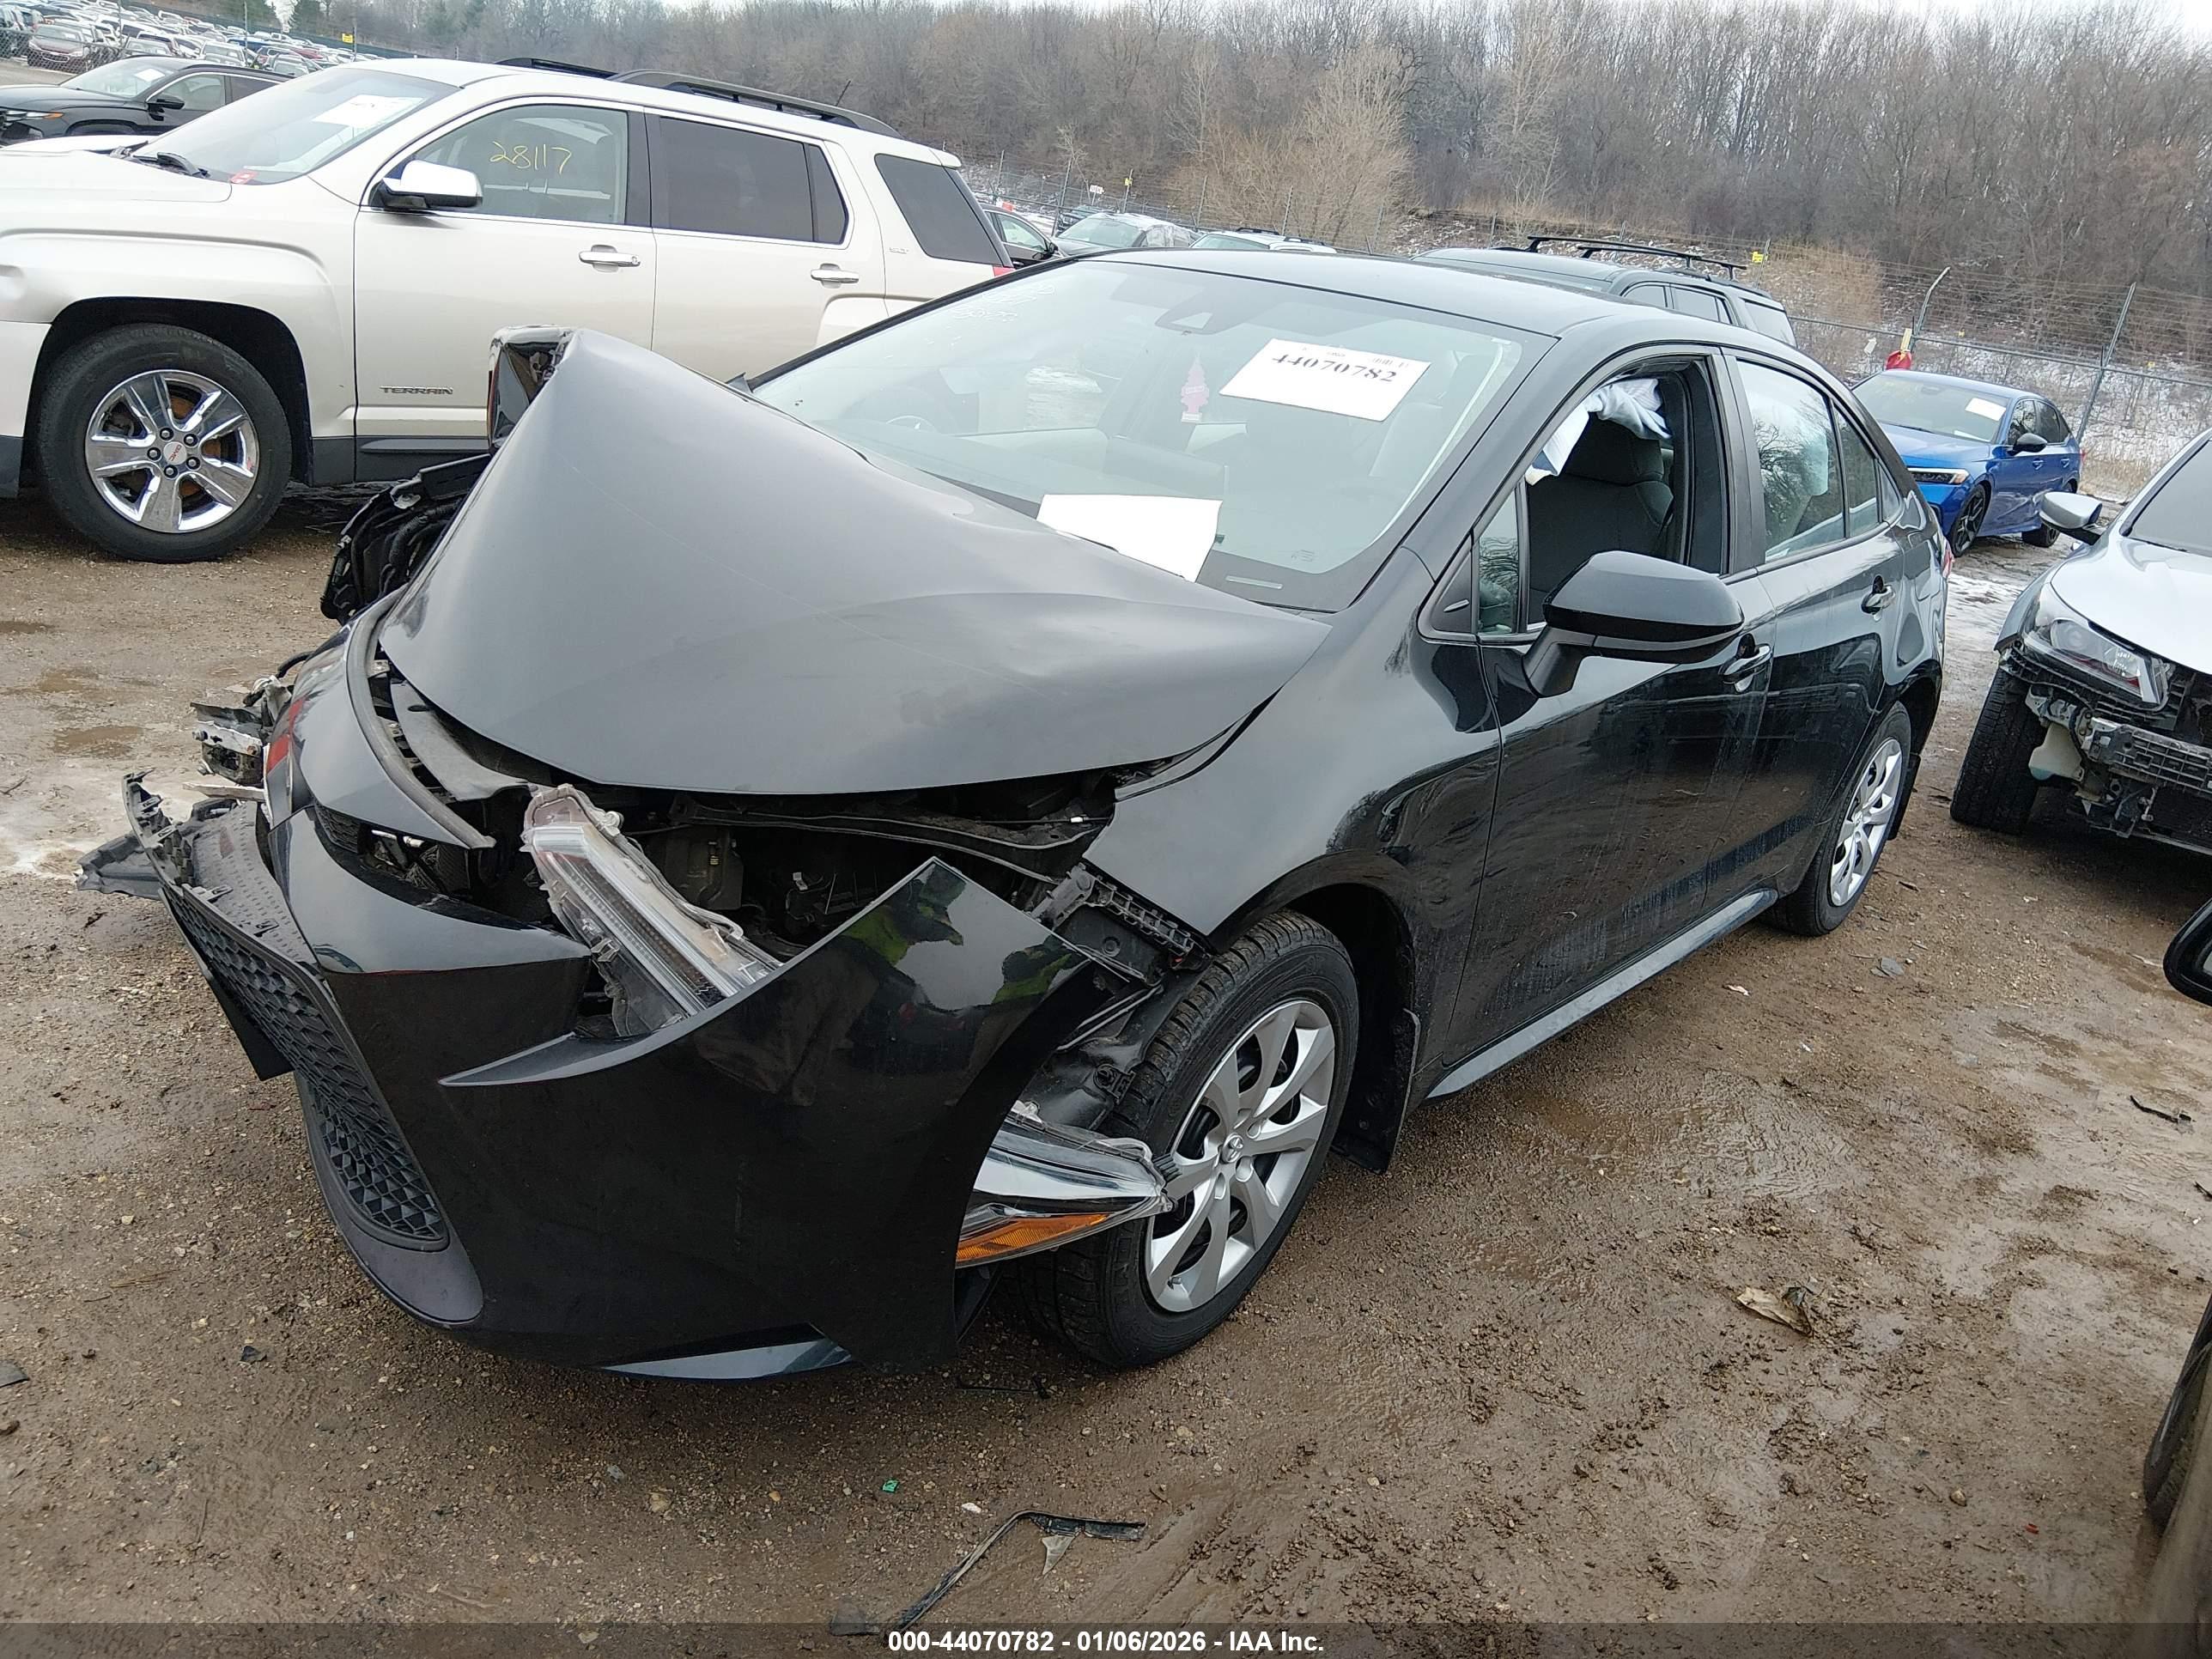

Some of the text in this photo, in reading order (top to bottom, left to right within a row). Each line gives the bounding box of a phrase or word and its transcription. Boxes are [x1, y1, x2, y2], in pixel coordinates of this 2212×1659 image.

[489, 140, 572, 174] 28117
[1272, 353, 1398, 382] 44070782
[379, 386, 453, 395] TERRAIN
[168, 444, 182, 462] GMC
